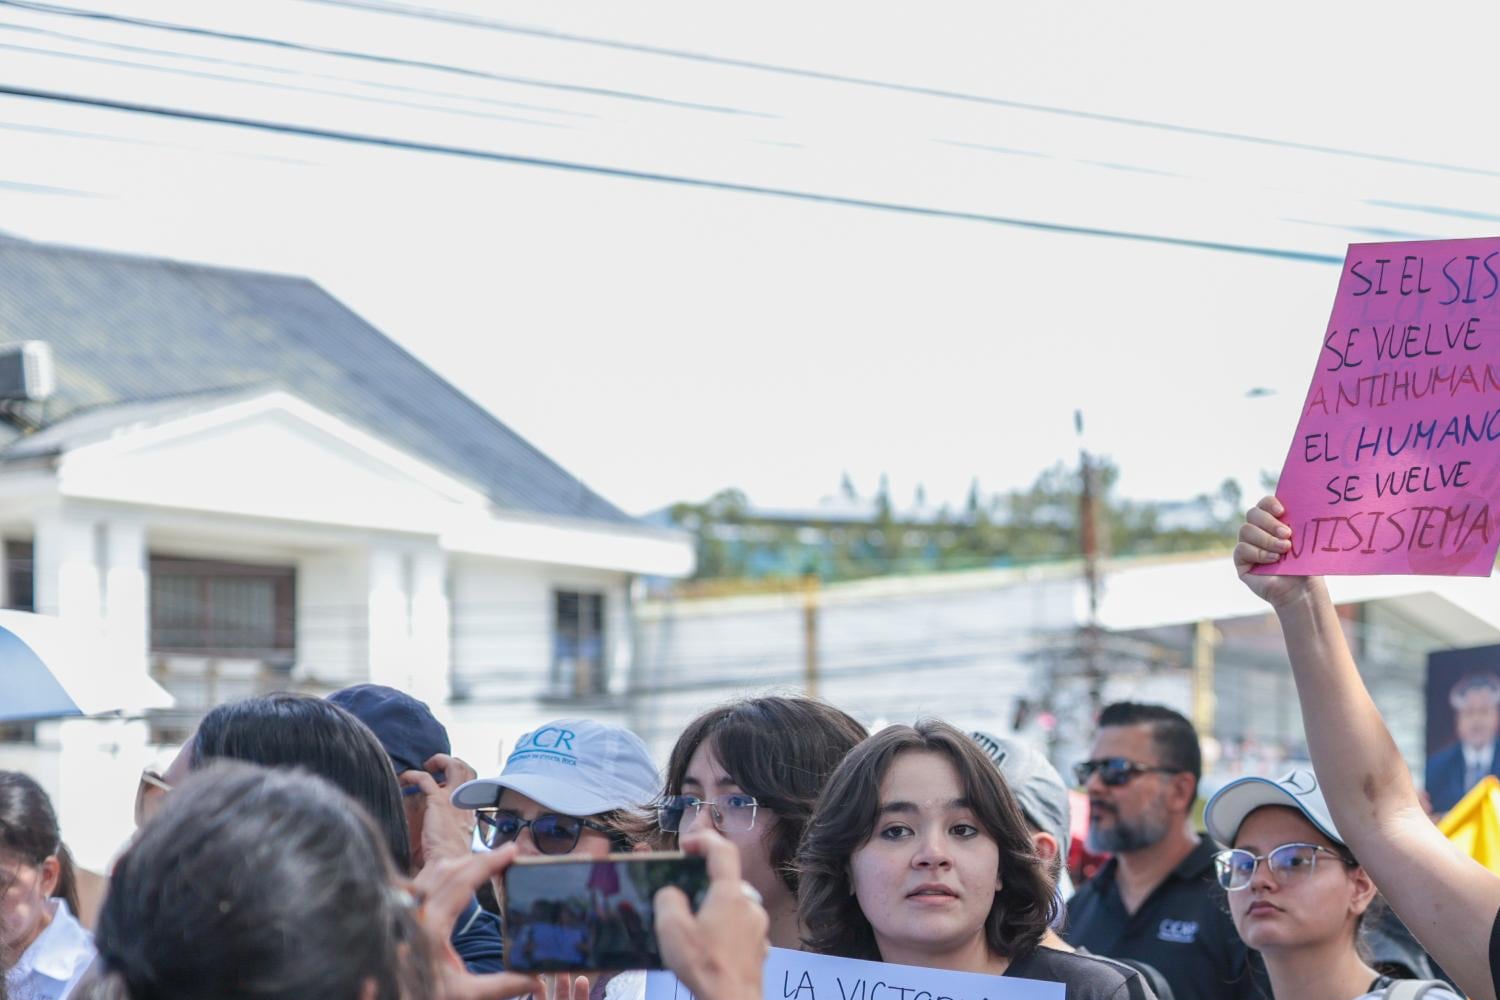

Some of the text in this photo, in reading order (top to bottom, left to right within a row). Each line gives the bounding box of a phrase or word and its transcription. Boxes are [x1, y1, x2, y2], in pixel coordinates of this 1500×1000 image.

[1350, 259, 1391, 296] SI
[1400, 256, 1432, 296] EL
[1324, 317, 1482, 371] SE VUELVE
[1304, 432, 1339, 463] EL
[1326, 461, 1472, 505] SE VUELVE
[1280, 504, 1489, 564] NTISISTEMA
